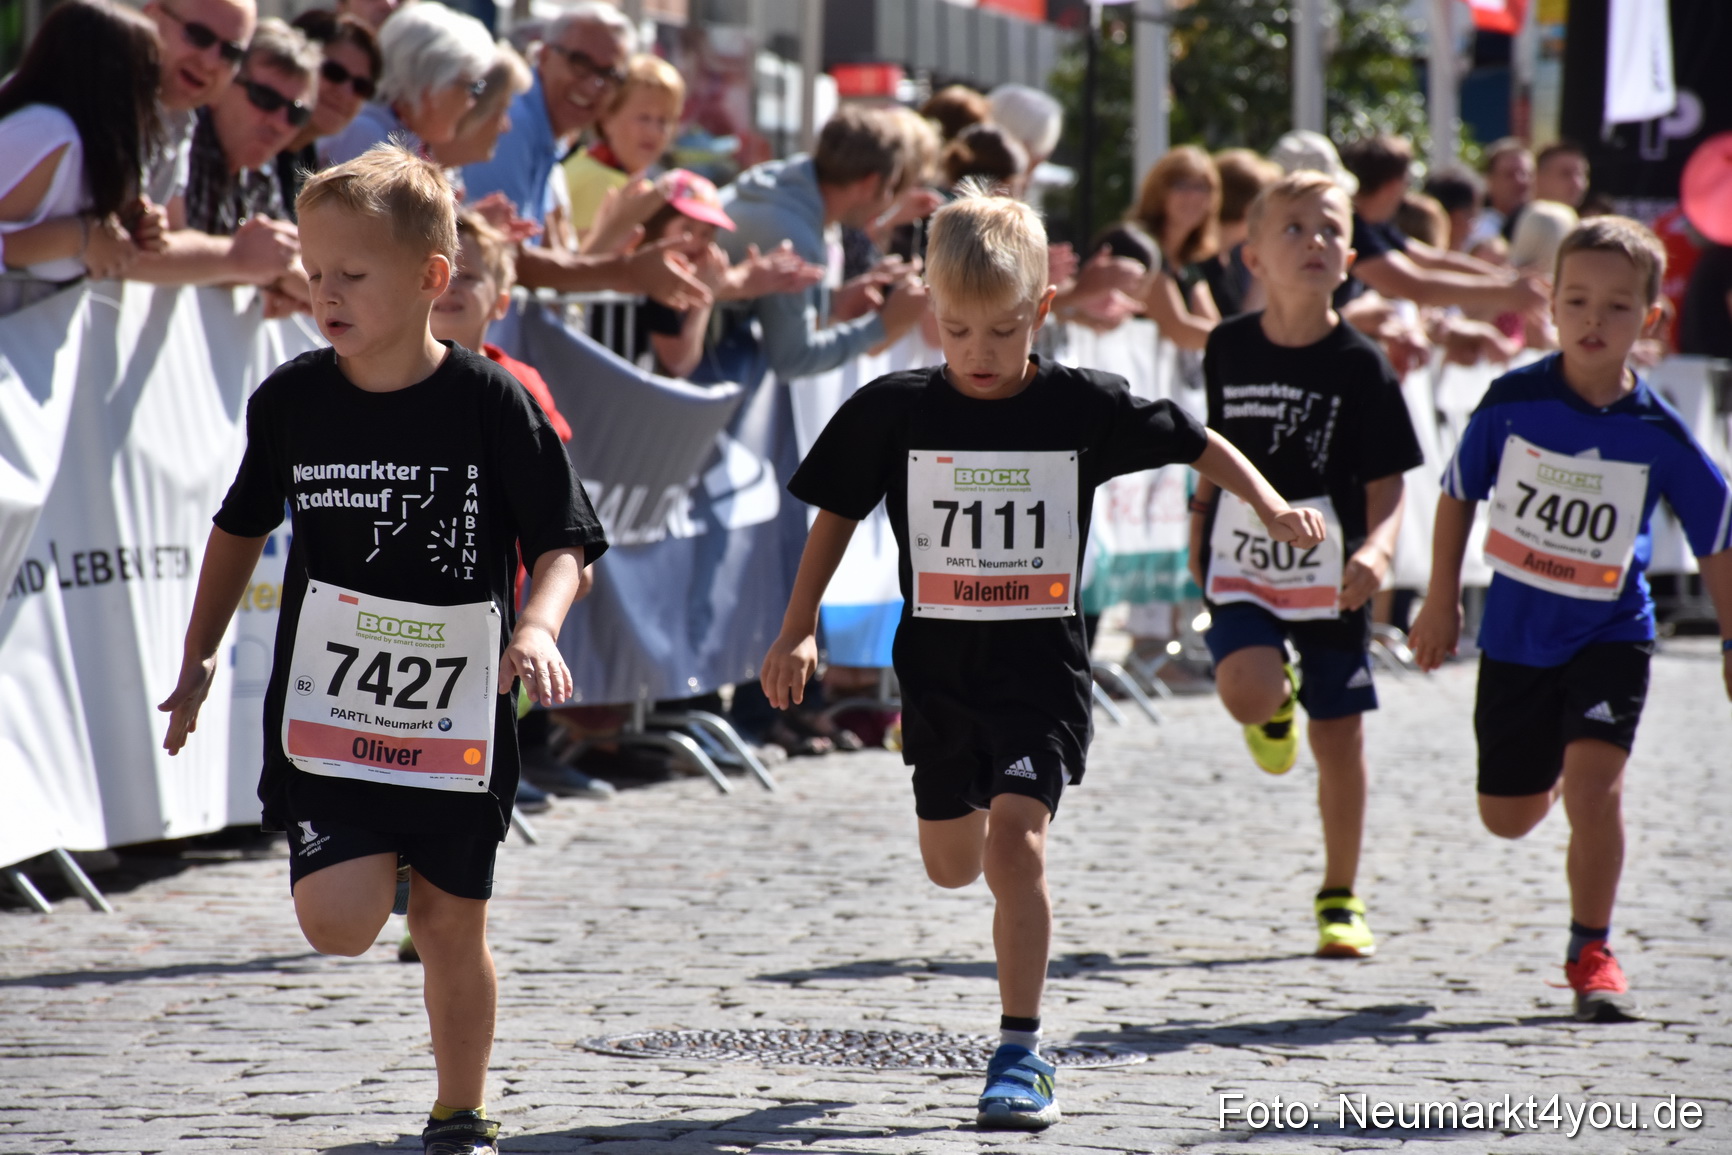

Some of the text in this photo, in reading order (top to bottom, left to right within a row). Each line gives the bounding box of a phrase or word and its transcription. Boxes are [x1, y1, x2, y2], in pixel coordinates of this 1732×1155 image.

[293, 460, 421, 484] Neumarkter
[954, 468, 1031, 486] BOCK
[1536, 463, 1603, 490] BOCK
[462, 464, 479, 580] BAMBINI
[1516, 480, 1617, 543] 7400
[933, 500, 1045, 549] 7111
[917, 537, 929, 547] B2
[1232, 530, 1322, 571] 7502
[946, 557, 1028, 569] PARTL Neumarkt
[1523, 552, 1576, 580] Anton
[954, 580, 1030, 602] Valentin
[357, 611, 446, 641] BOCK
[355, 632, 446, 650] inspired by smart concepts
[297, 679, 312, 692] B2
[326, 641, 468, 709] 7427
[330, 707, 434, 730] PARTL Neumarkt
[352, 737, 423, 766] Oliver
[1005, 769, 1037, 780] adidas
